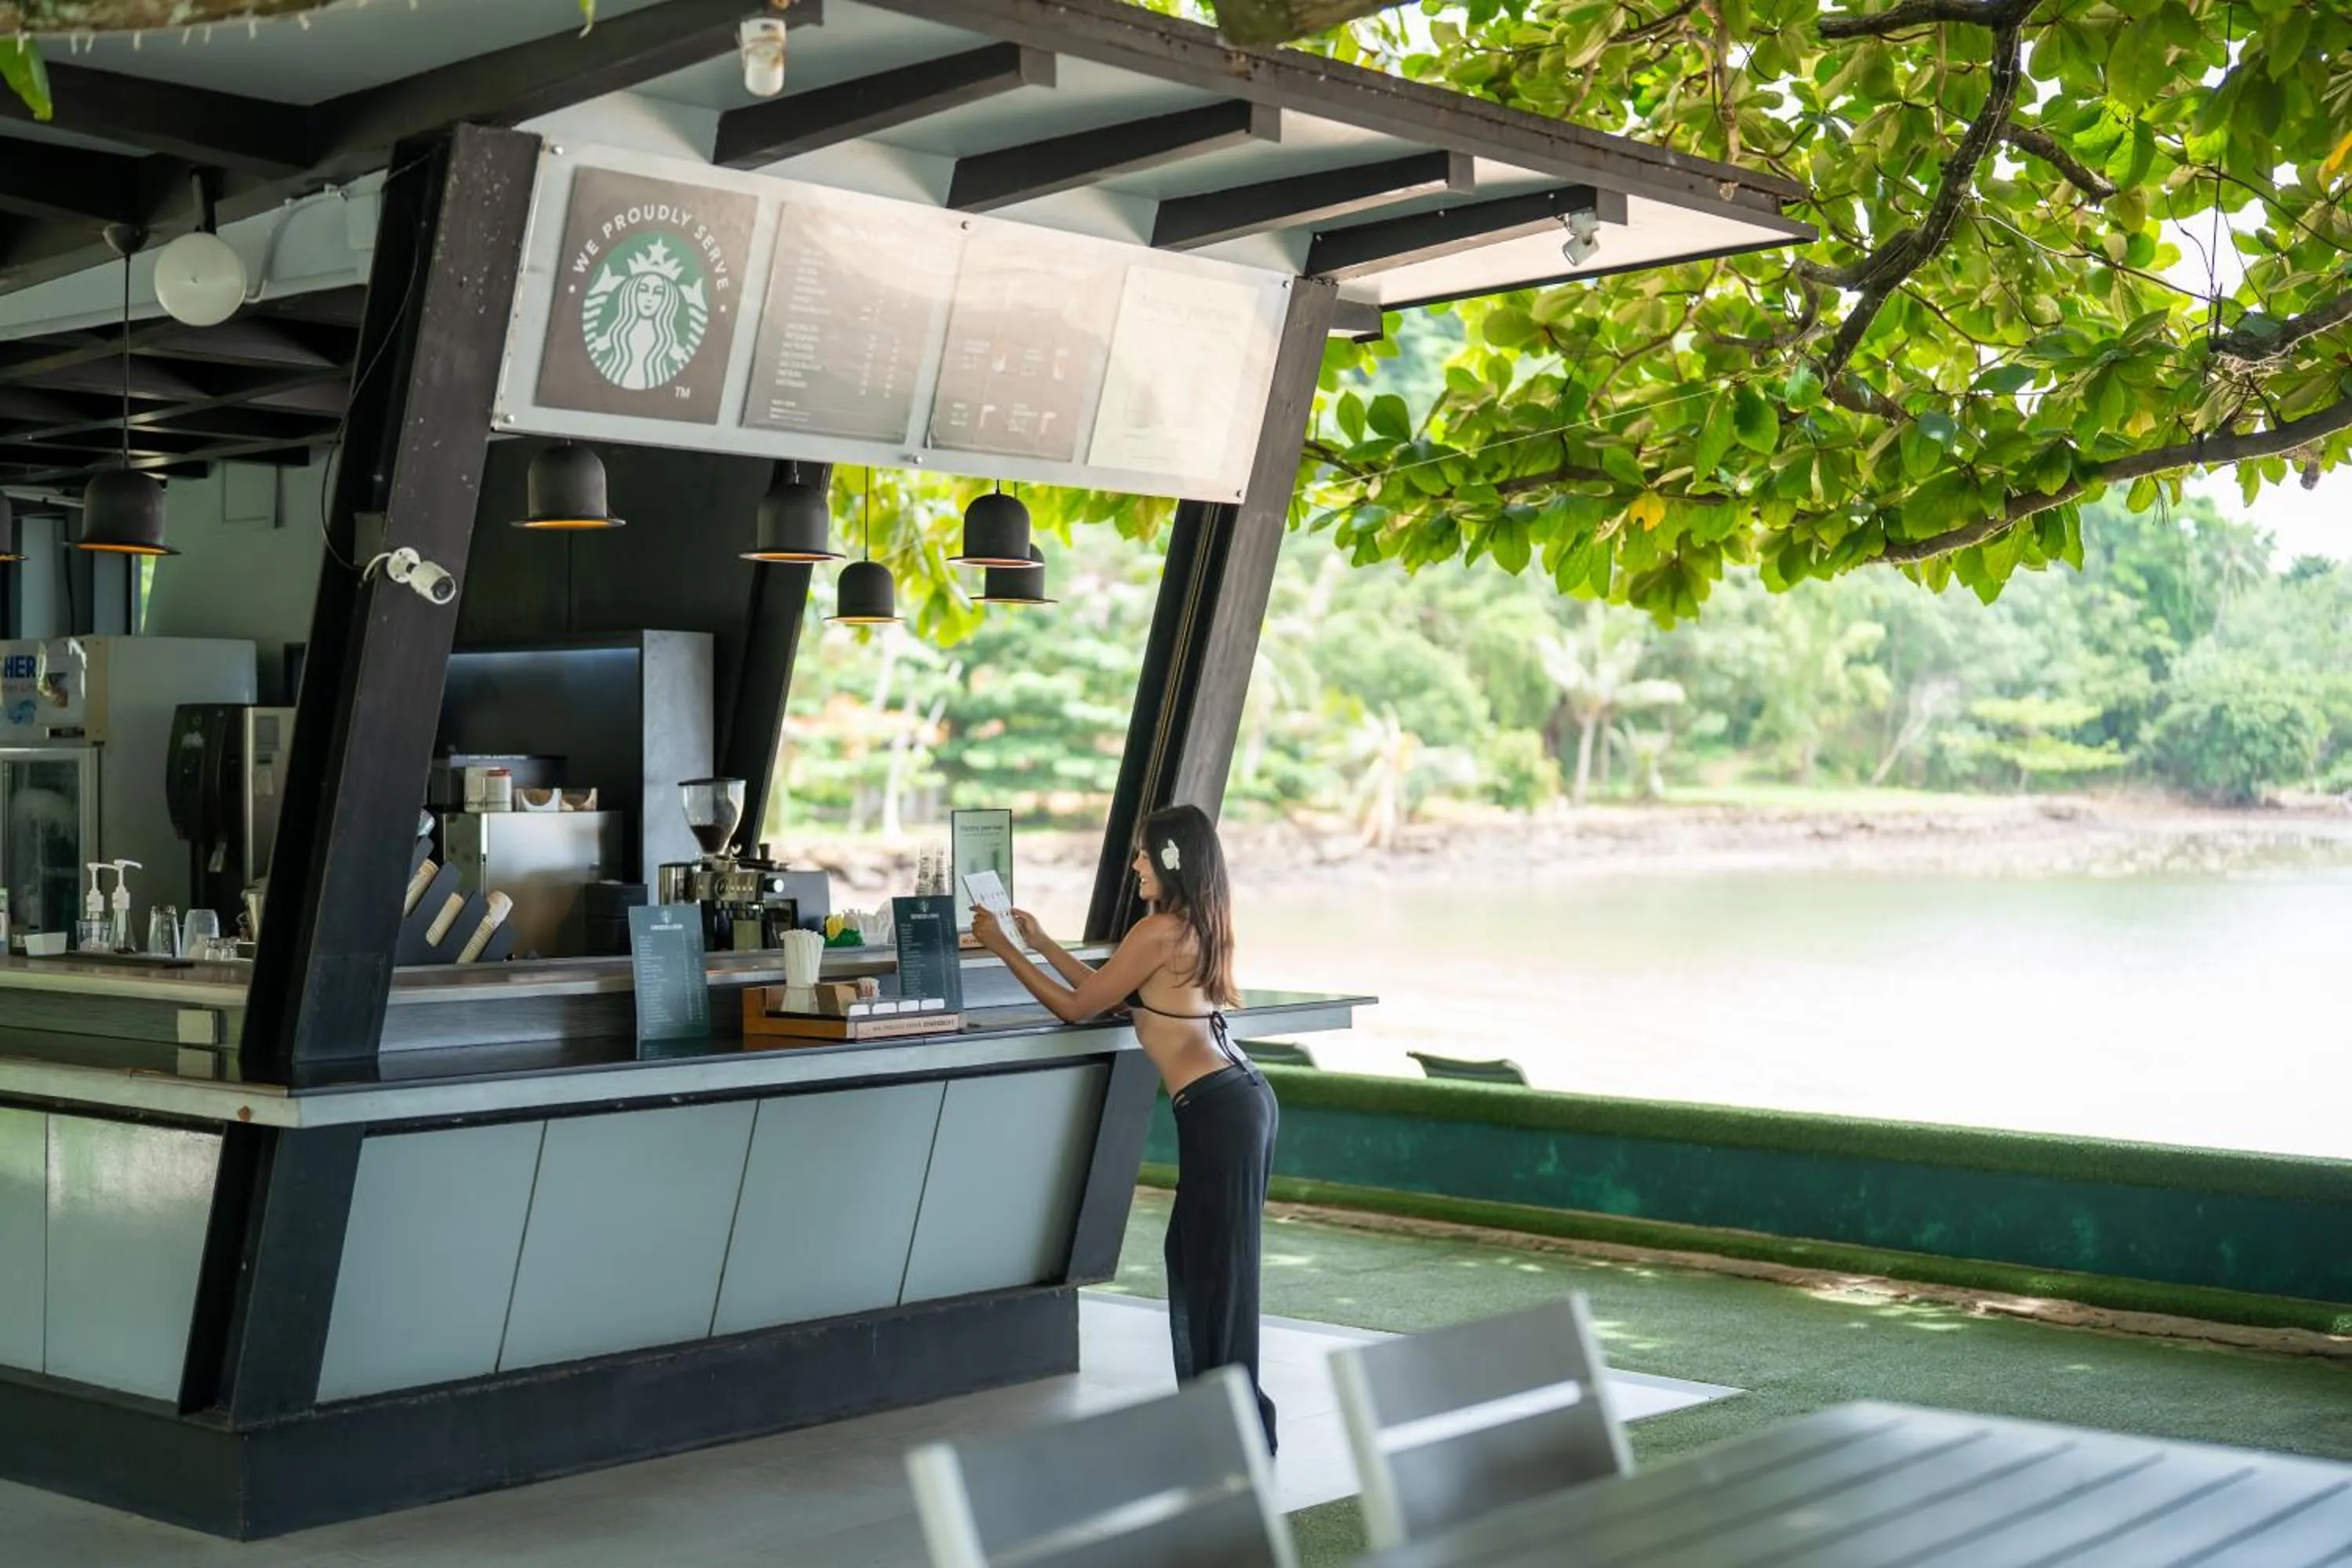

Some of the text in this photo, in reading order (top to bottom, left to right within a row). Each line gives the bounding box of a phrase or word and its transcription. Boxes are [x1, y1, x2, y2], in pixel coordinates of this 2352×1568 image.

[572, 204, 729, 290] WE PROUDLY SERVE
[675, 386, 691, 401] TM
